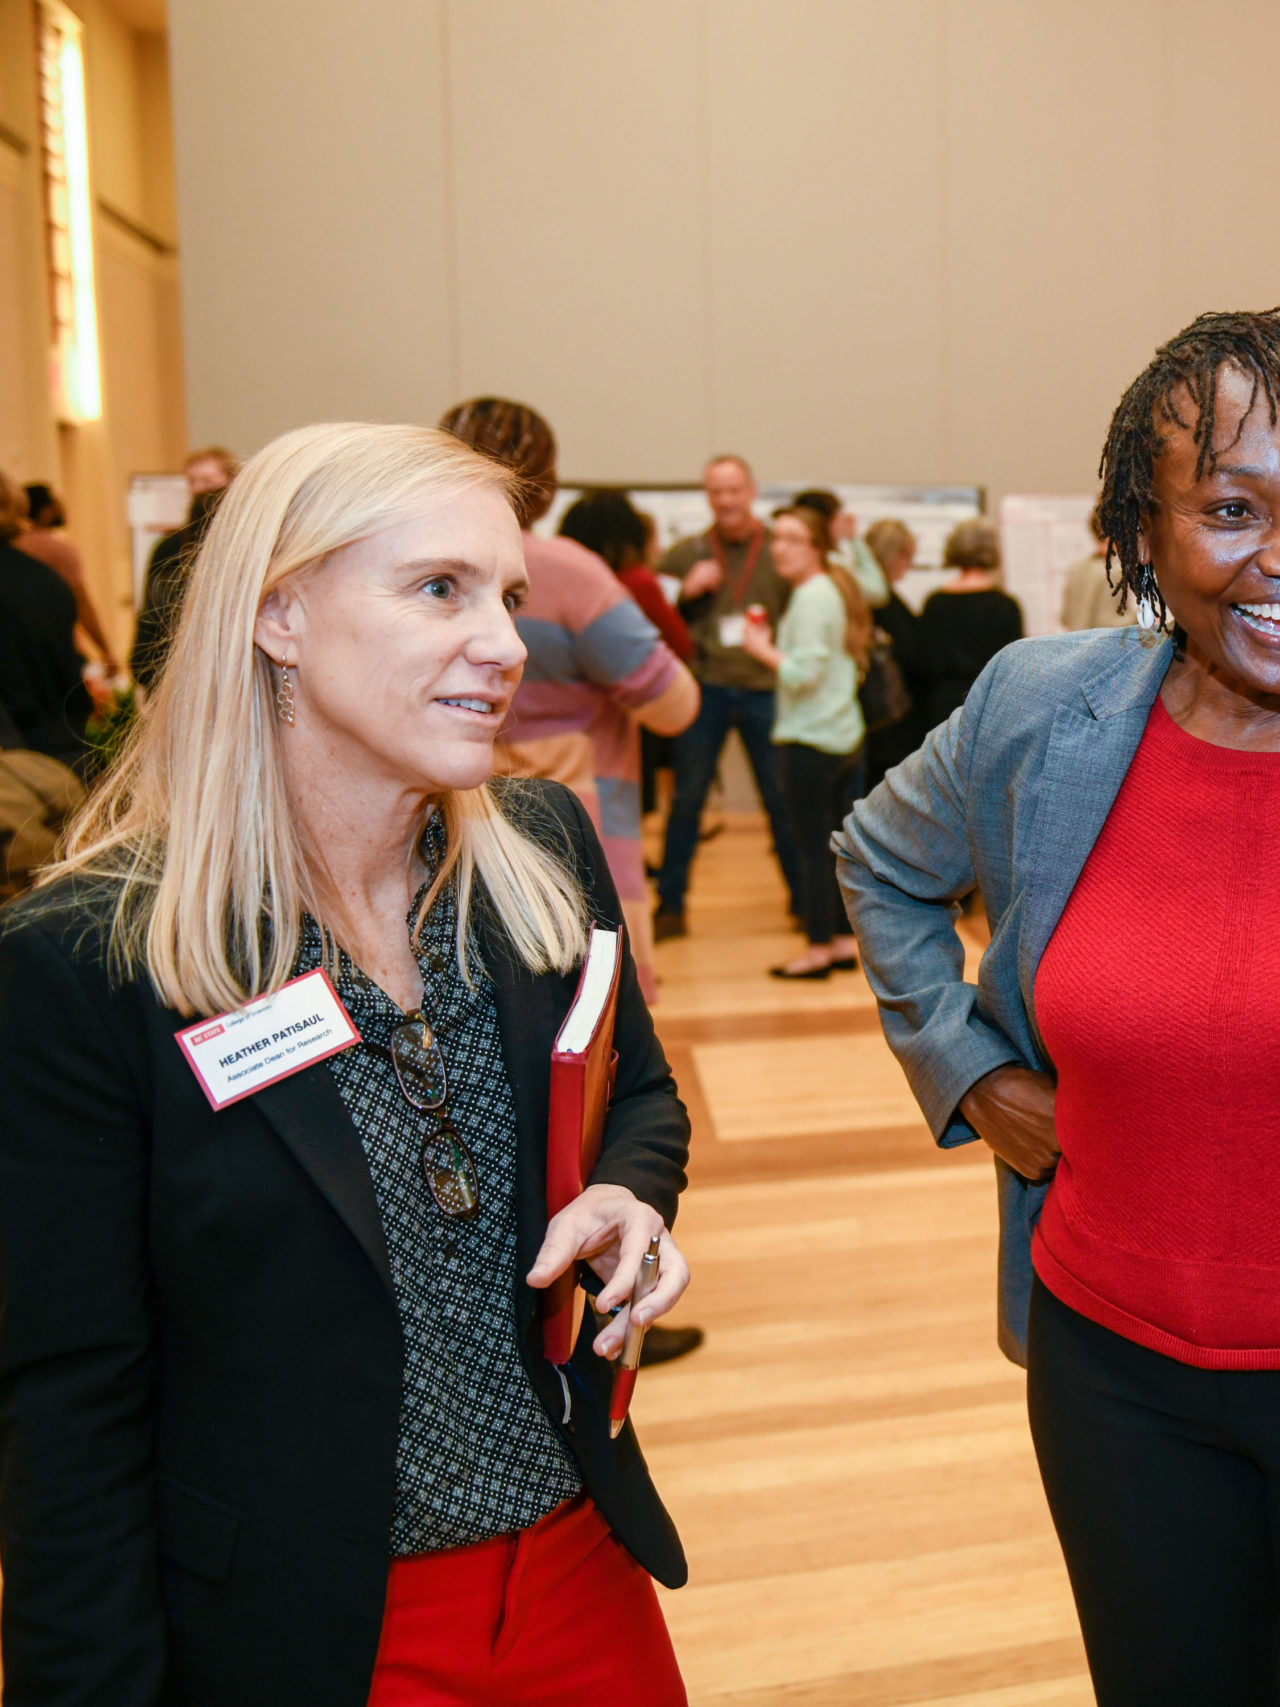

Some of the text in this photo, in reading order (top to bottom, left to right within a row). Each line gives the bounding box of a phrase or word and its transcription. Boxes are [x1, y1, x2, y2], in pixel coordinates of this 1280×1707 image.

[193, 1027, 221, 1044] NC STATE
[219, 1014, 325, 1068] HEATHER PATISAUL
[227, 1028, 333, 1082] Associate Dean for Research
